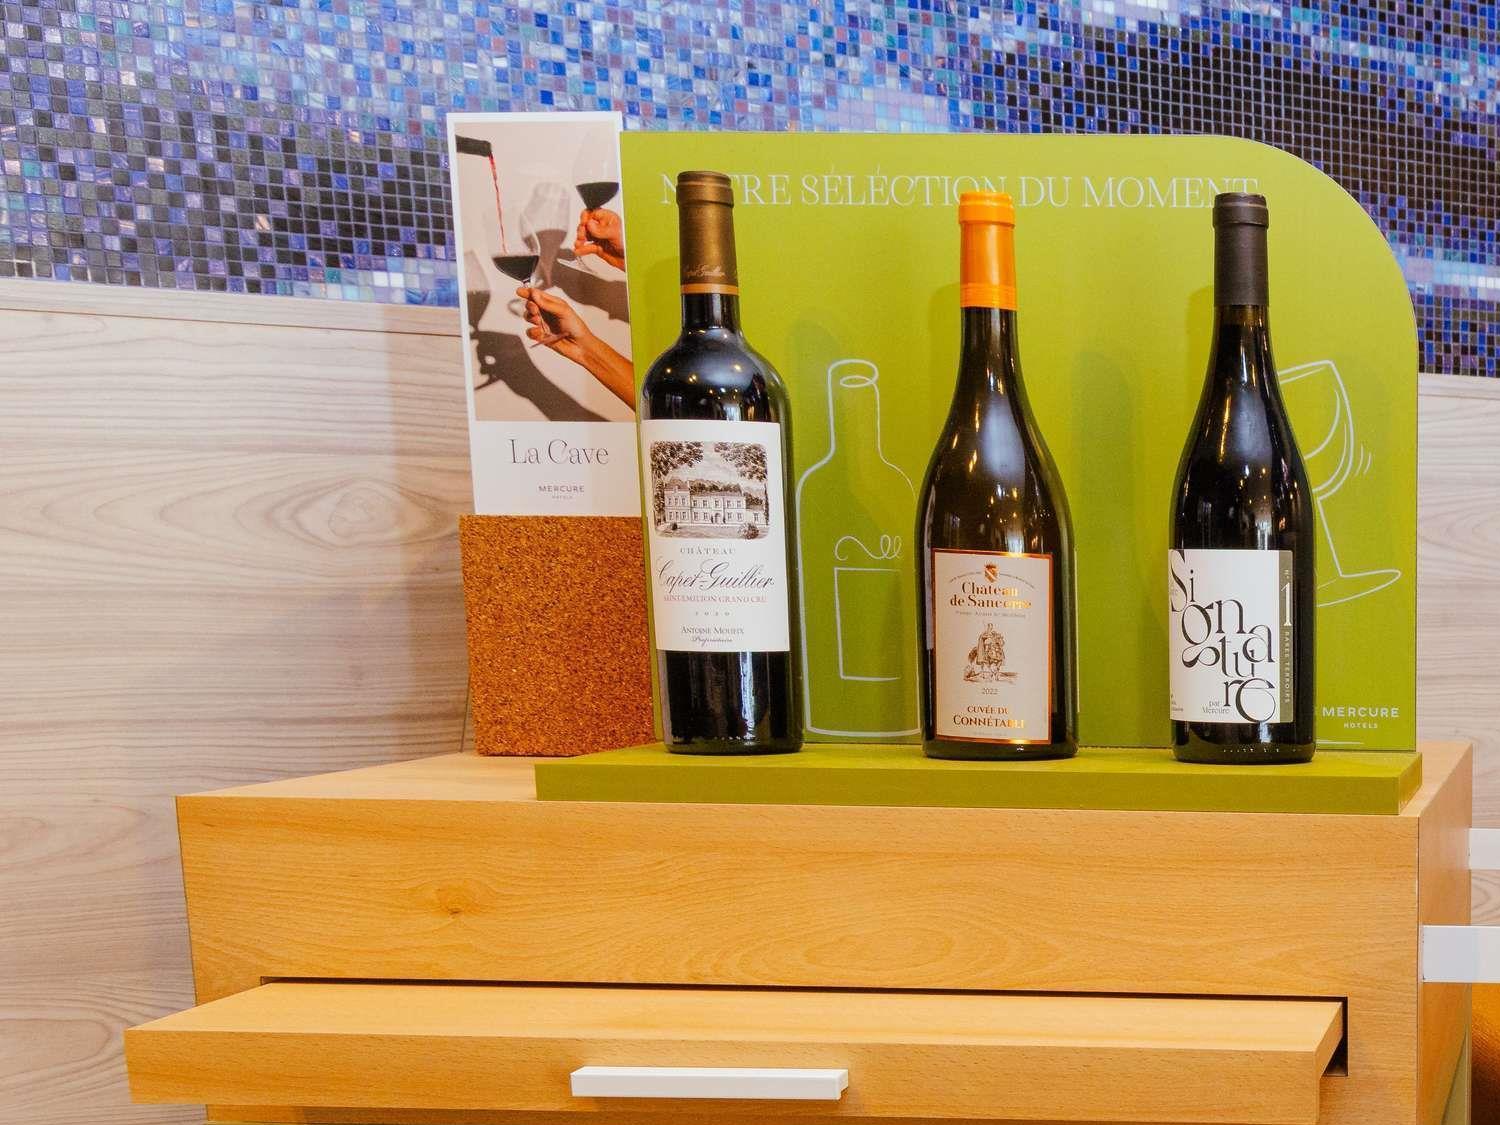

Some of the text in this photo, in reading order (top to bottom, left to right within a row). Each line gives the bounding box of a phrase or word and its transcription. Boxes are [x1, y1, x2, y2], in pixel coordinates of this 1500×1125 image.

[1019, 176, 1072, 208] DU
[508, 438, 609, 465] La Cave
[538, 485, 585, 493] MERCURE
[950, 594, 1031, 609] de Sancerre
[1281, 582, 1292, 627] 1
[1322, 706, 1400, 718] MERCURE
